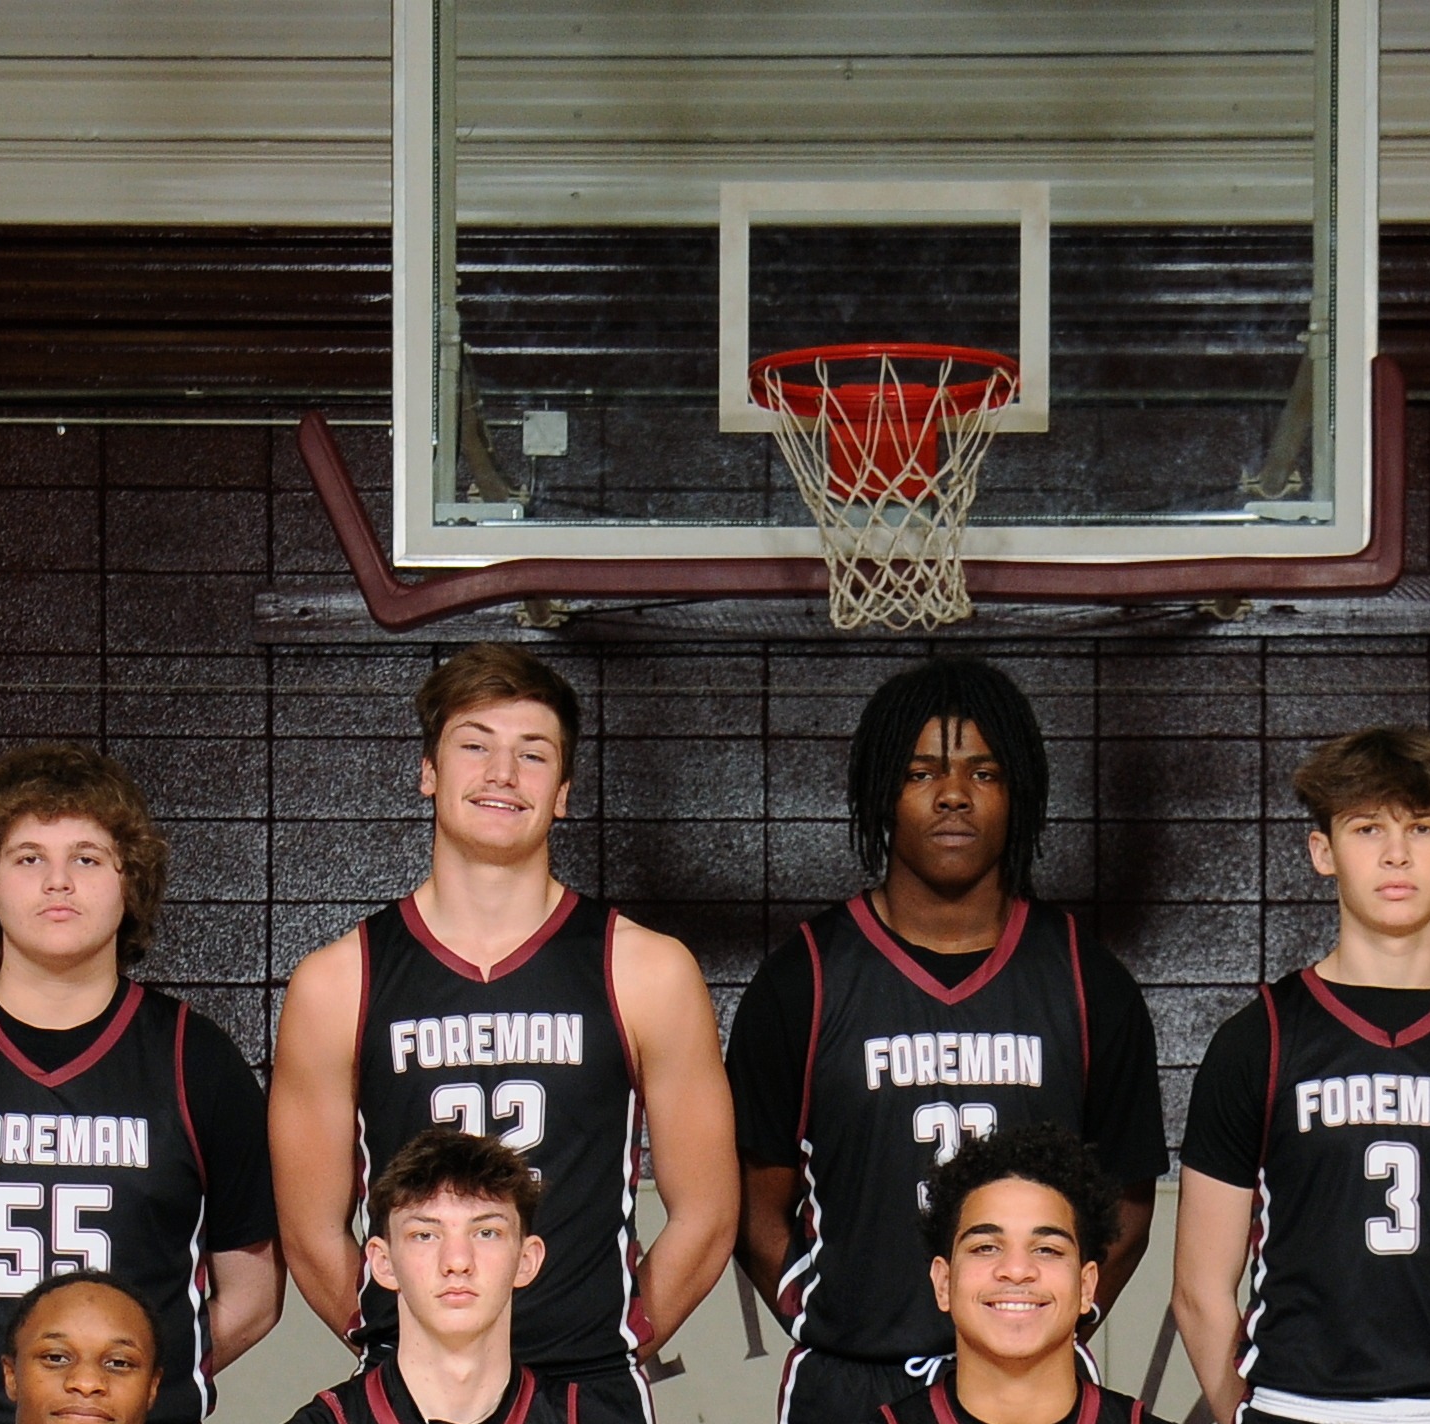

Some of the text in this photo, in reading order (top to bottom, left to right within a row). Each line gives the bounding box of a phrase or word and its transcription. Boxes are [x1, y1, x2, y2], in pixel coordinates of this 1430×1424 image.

[390, 1012, 583, 1074] FOREMAN
[864, 1032, 1043, 1091] FOREMAN
[1364, 1140, 1420, 1256] 3
